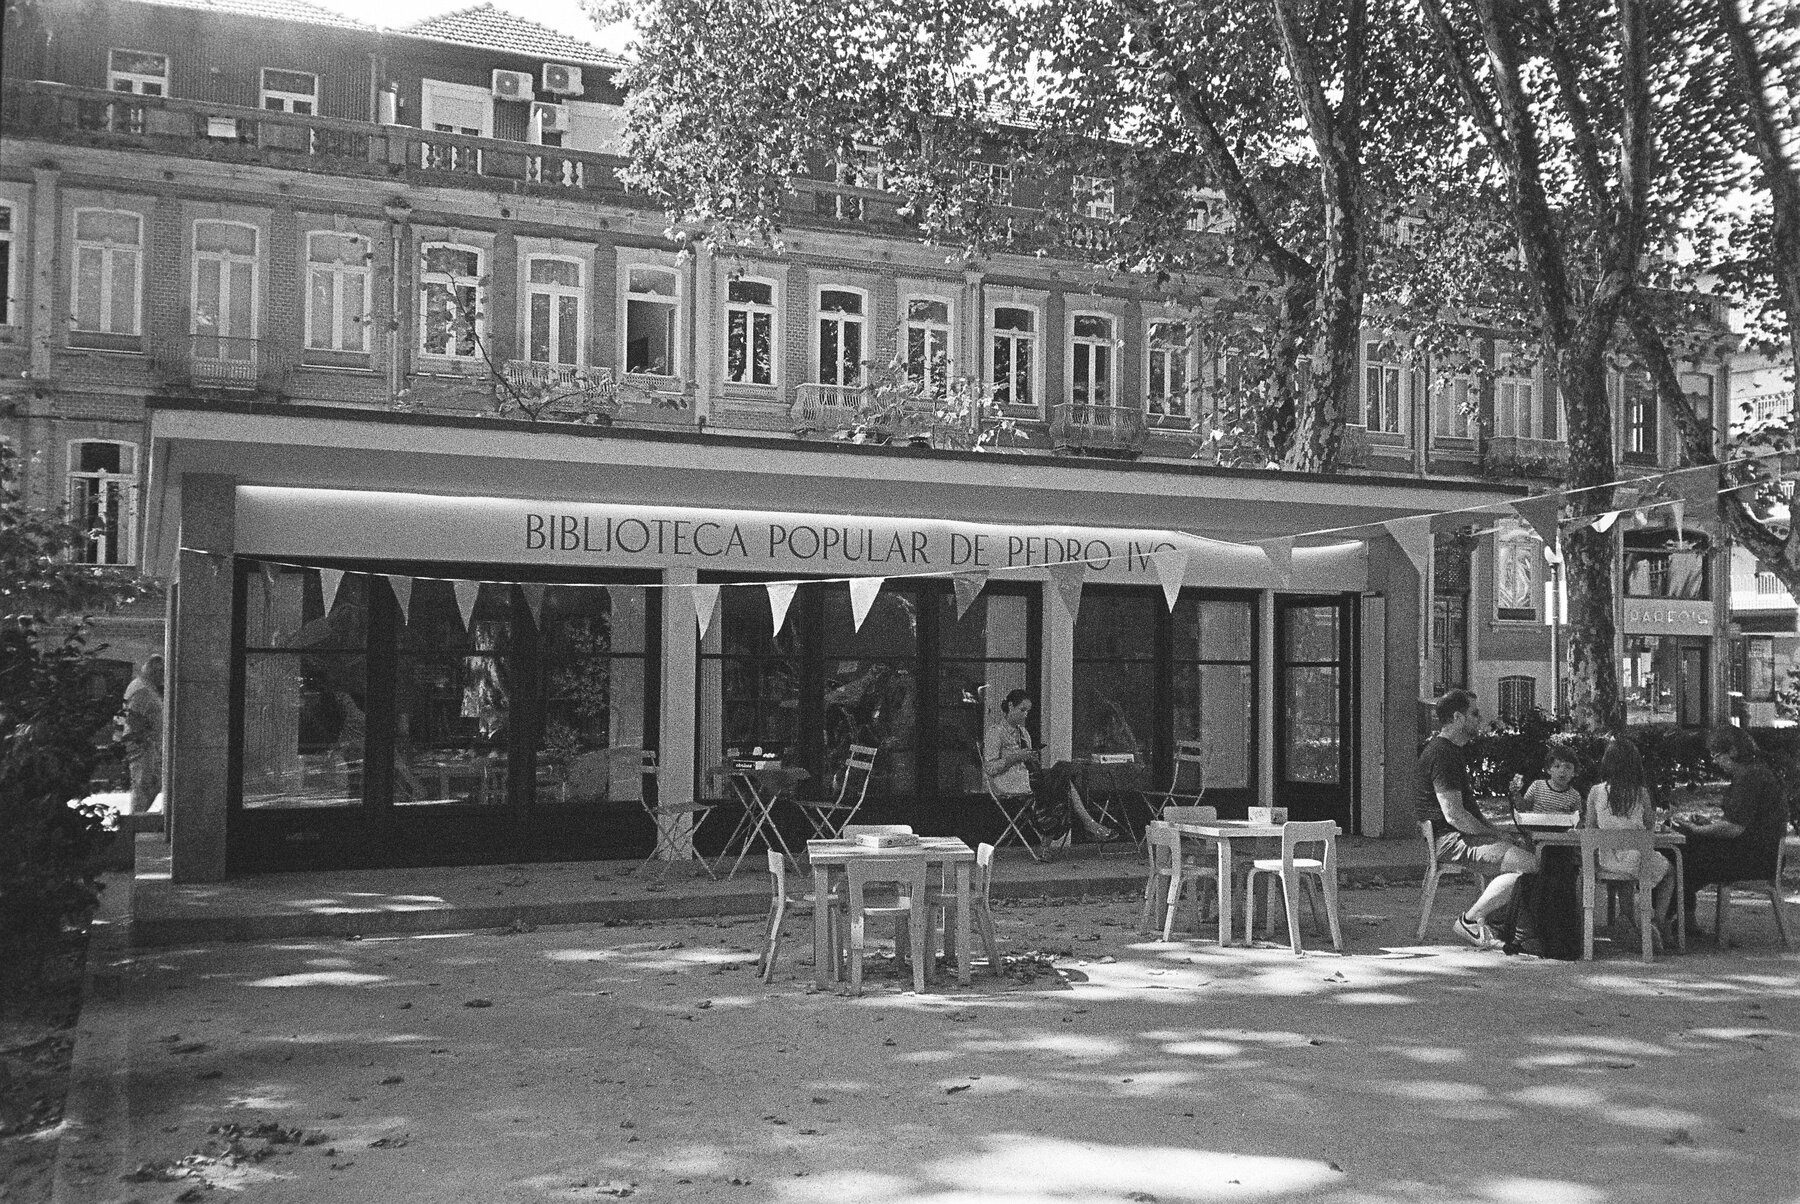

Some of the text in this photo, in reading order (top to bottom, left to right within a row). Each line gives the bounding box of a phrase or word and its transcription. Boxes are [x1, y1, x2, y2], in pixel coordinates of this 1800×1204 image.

[525, 513, 749, 558] BIBLIOTECA
[768, 524, 931, 564] POPULAR
[950, 533, 990, 567] DE
[1008, 535, 1112, 571] PEDRO
